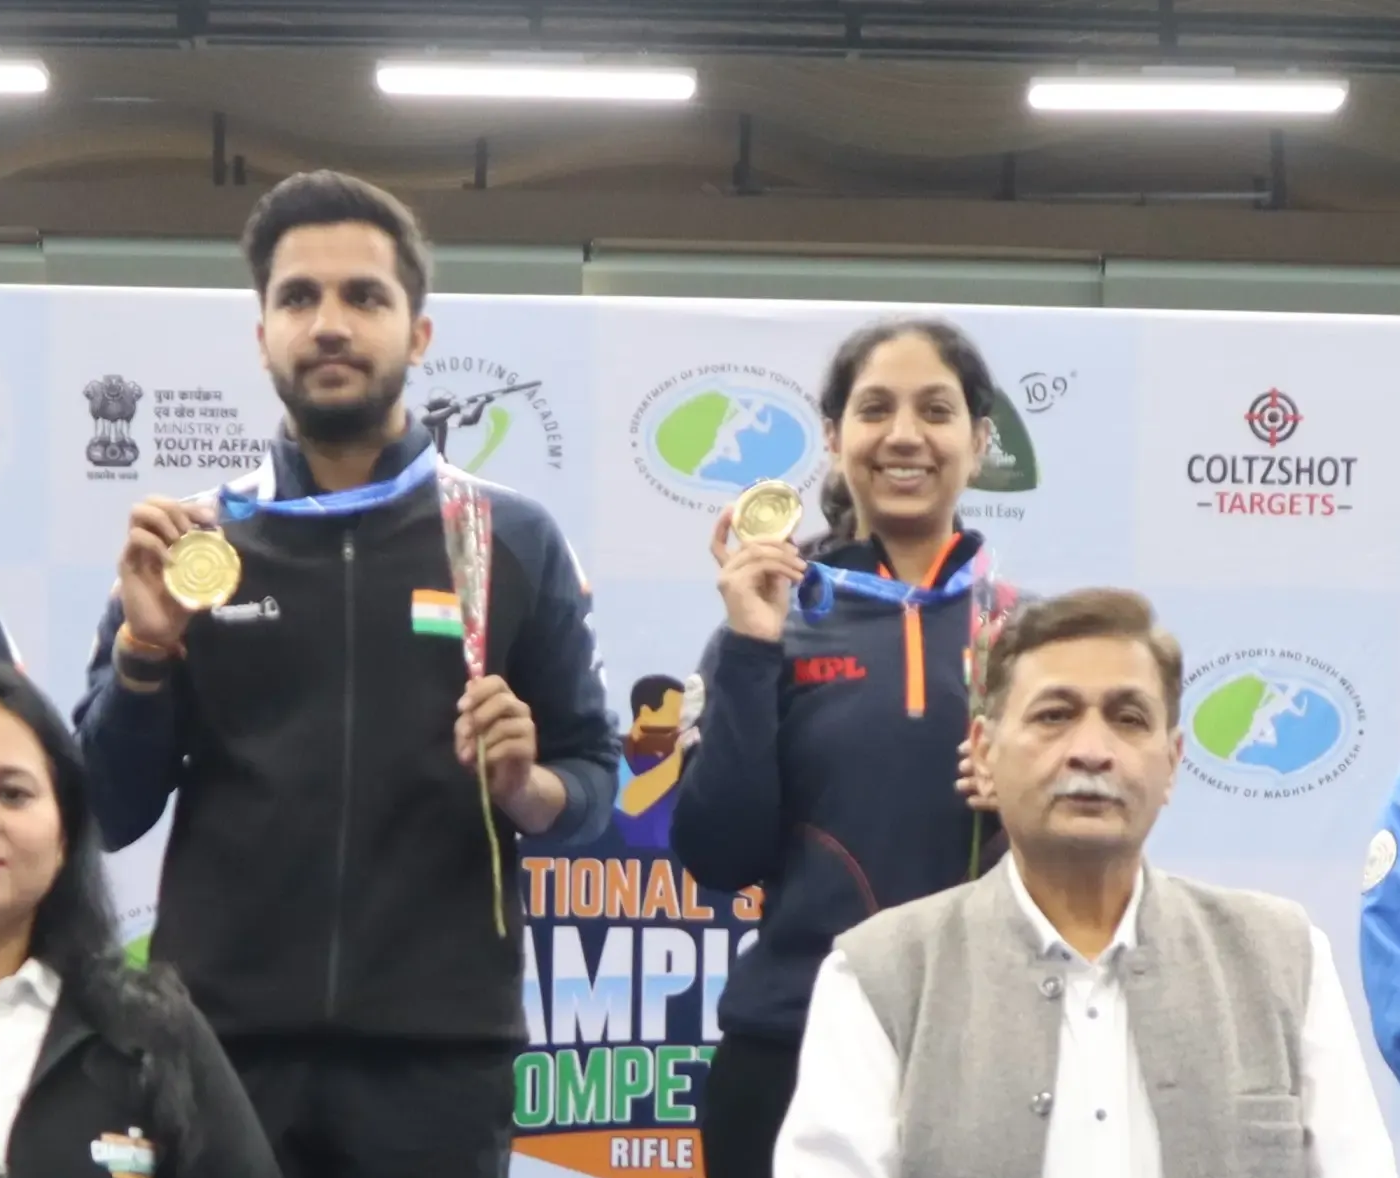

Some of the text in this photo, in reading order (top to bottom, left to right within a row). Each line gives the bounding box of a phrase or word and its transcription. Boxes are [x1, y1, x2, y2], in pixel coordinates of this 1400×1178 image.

[423, 356, 563, 470] SHOOTING ACADEMY
[629, 364, 803, 434] DEPARTMENT OF SPORTS AND YOUTH
[154, 422, 245, 436] MINISTRY OF
[154, 437, 213, 451] YOUTH
[153, 454, 261, 469] AND SPORTS
[1187, 454, 1358, 487] COLTZSHOT
[634, 456, 703, 510] GOVERNMENT
[997, 504, 1025, 521] Easy
[1215, 491, 1335, 516] TARGETS
[794, 656, 867, 682] MPL
[1182, 648, 1366, 722] TMENT OF SPORTS AND YOUTH WELFARE
[1181, 744, 1361, 799] VERNMENT OF MADHYA PRADESH
[521, 857, 714, 920] TIONAL
[512, 1045, 717, 1127] OMPE
[610, 1137, 693, 1168] RIFLE
